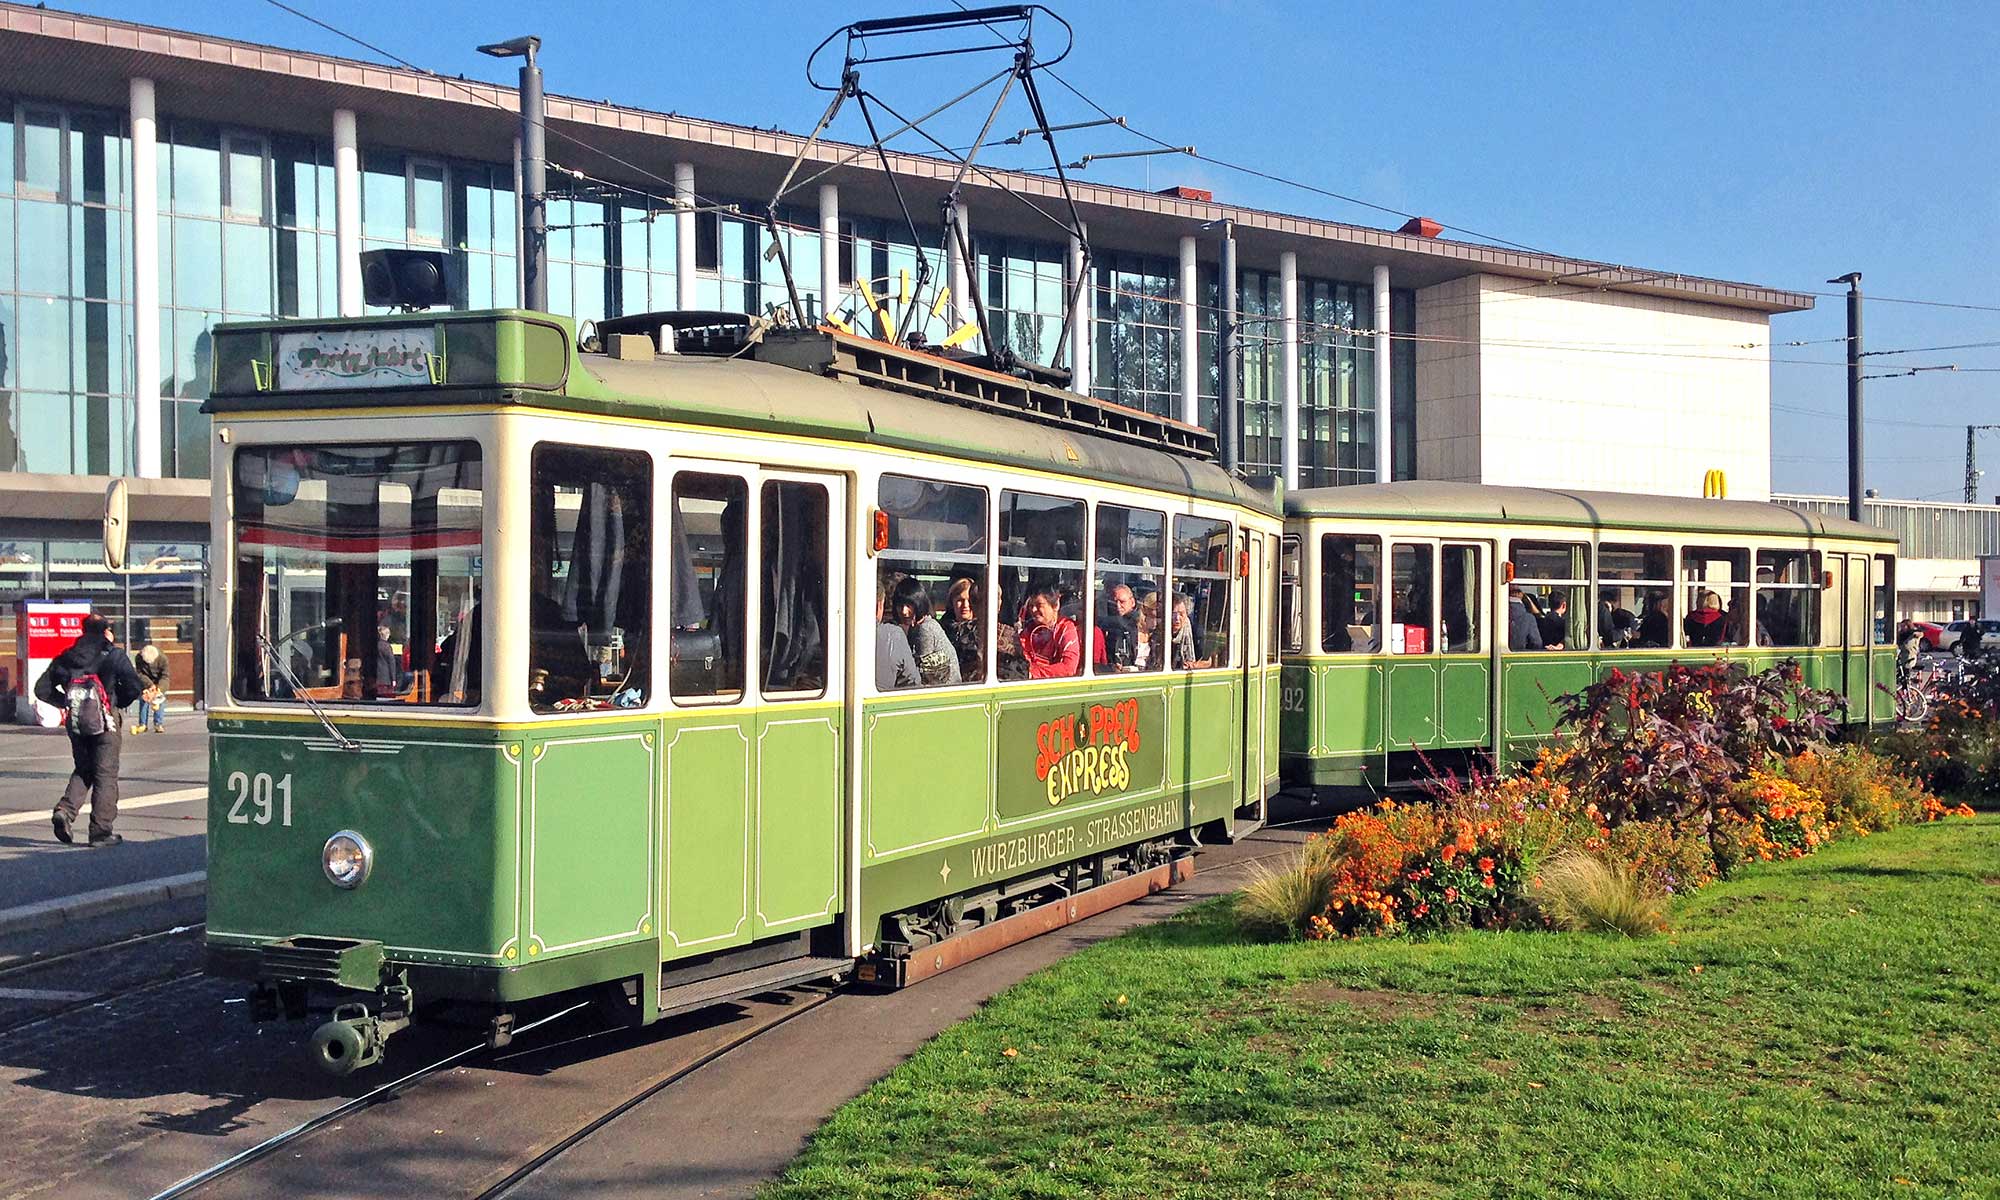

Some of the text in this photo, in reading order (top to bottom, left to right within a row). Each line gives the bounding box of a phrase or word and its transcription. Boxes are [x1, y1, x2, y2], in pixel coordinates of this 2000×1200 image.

[1281, 687, 1304, 712] 92
[227, 771, 292, 826] 291
[1046, 740, 1130, 806] EXPRESS
[1086, 798, 1180, 849] STRASSENBAHN
